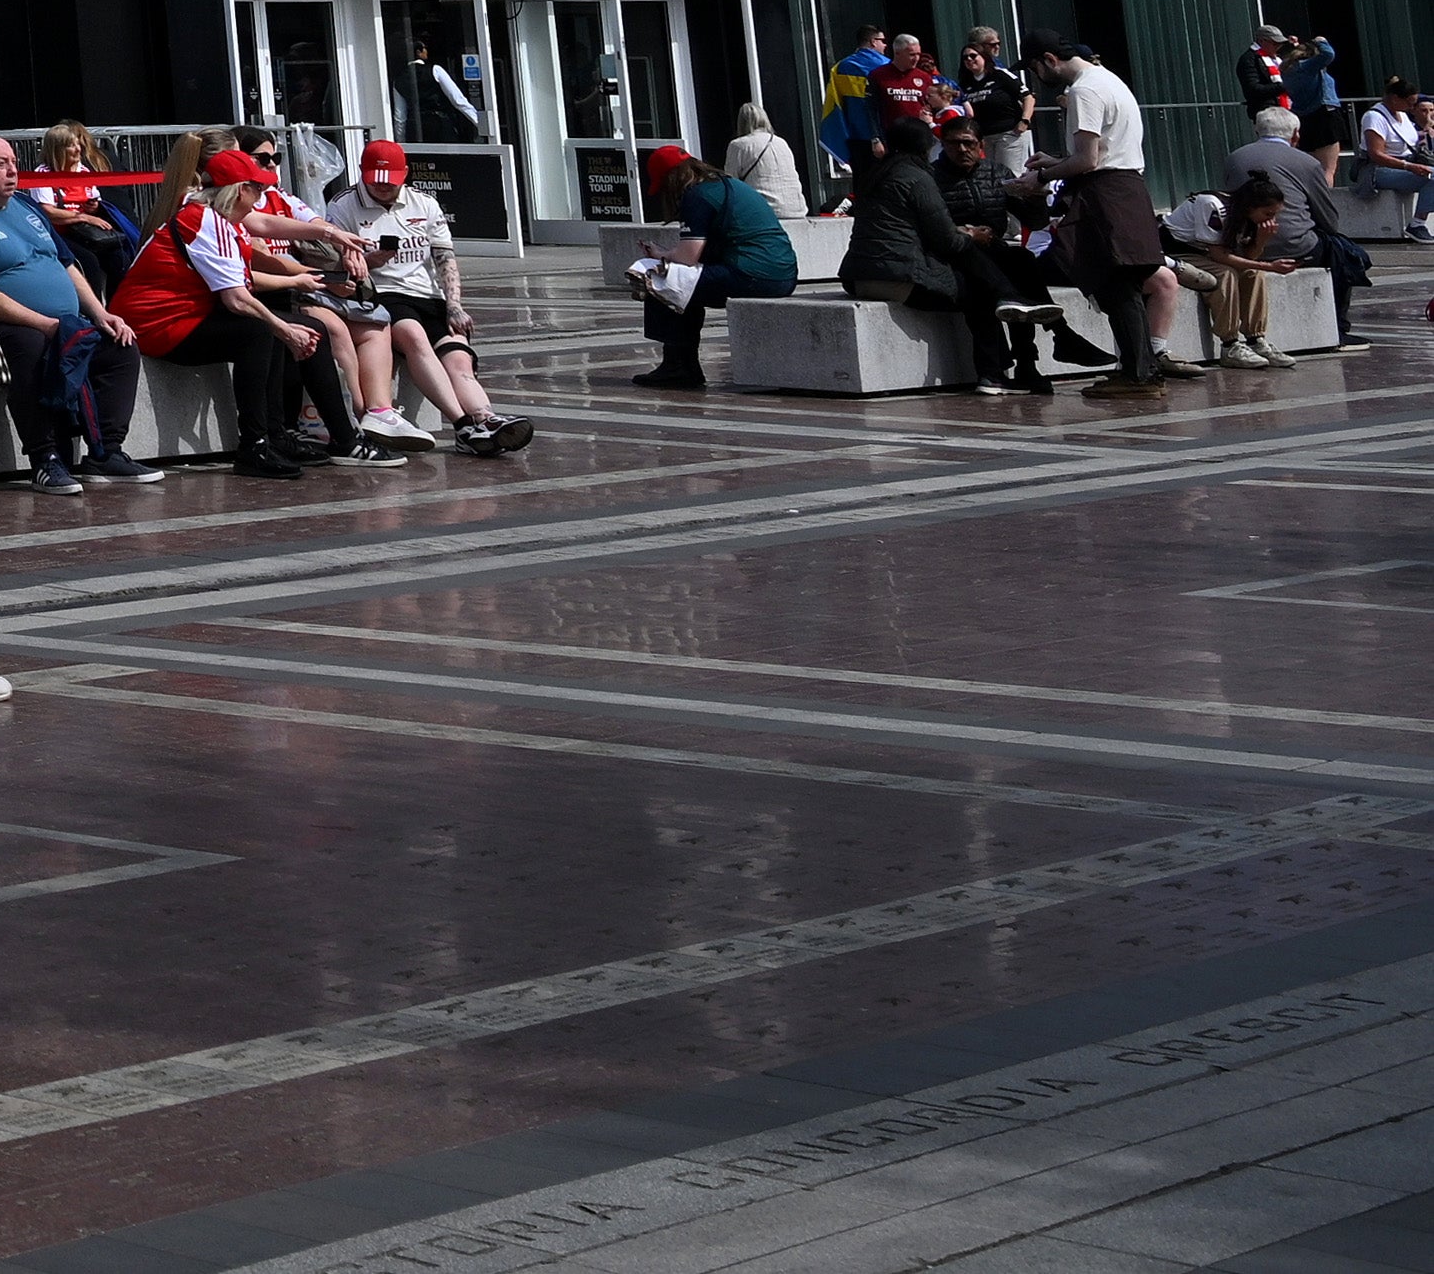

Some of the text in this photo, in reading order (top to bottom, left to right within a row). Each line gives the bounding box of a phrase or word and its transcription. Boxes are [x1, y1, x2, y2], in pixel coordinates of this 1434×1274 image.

[410, 162, 428, 171] THE
[411, 171, 451, 181] ARSENAL
[588, 174, 629, 184] STADIUM
[412, 180, 452, 191] STADIUM
[589, 183, 614, 193] TOUR
[591, 205, 632, 216] IN-STORE
[1110, 991, 1386, 1068] CRESCIT
[668, 1074, 1100, 1190] CONCORDIA
